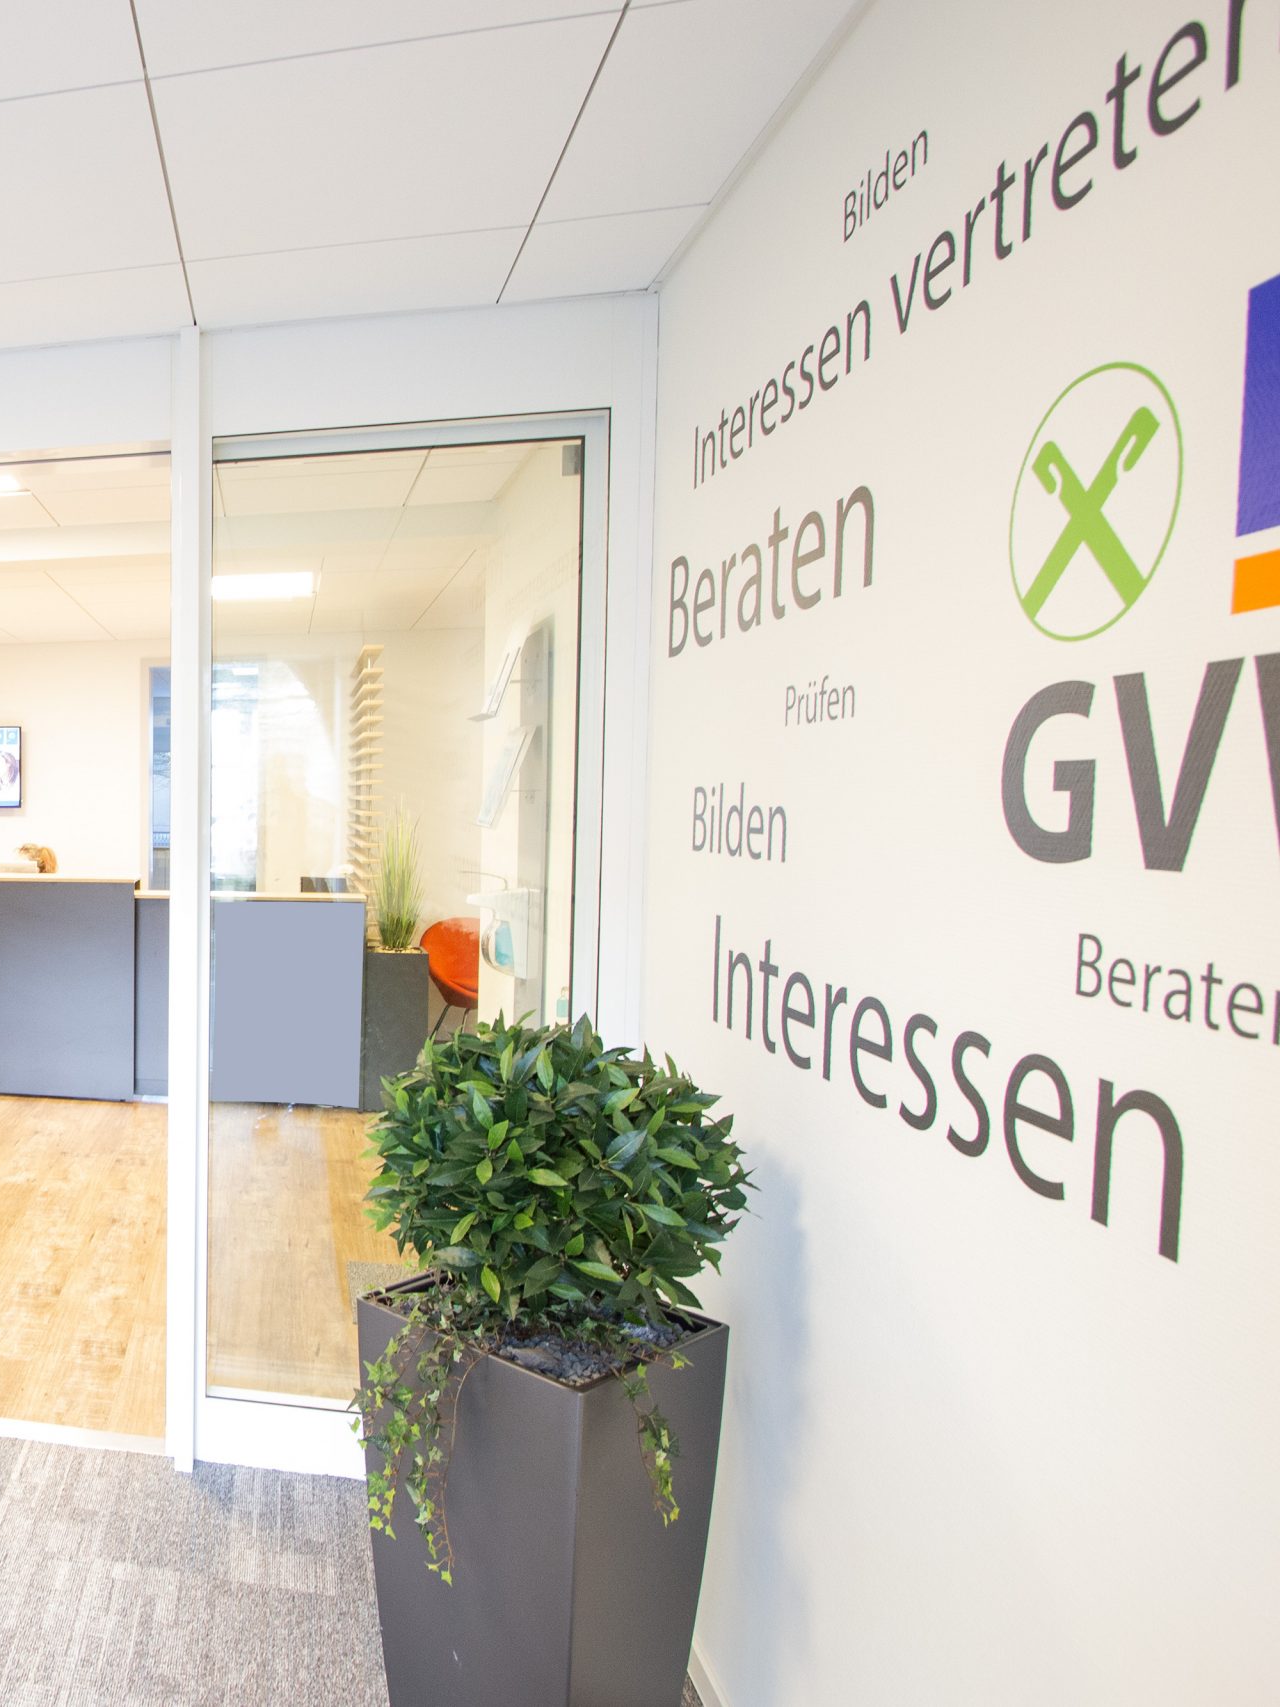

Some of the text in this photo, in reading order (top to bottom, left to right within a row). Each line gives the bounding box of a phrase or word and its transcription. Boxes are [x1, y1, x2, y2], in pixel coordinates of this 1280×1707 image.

[843, 129, 929, 243] Bilden
[692, 298, 872, 490] Interessen
[667, 484, 875, 659] Beraten
[784, 674, 856, 727] Prüfen
[1000, 651, 1280, 873] GV
[691, 781, 787, 864] Bilden
[712, 914, 1184, 1264] Interessen
